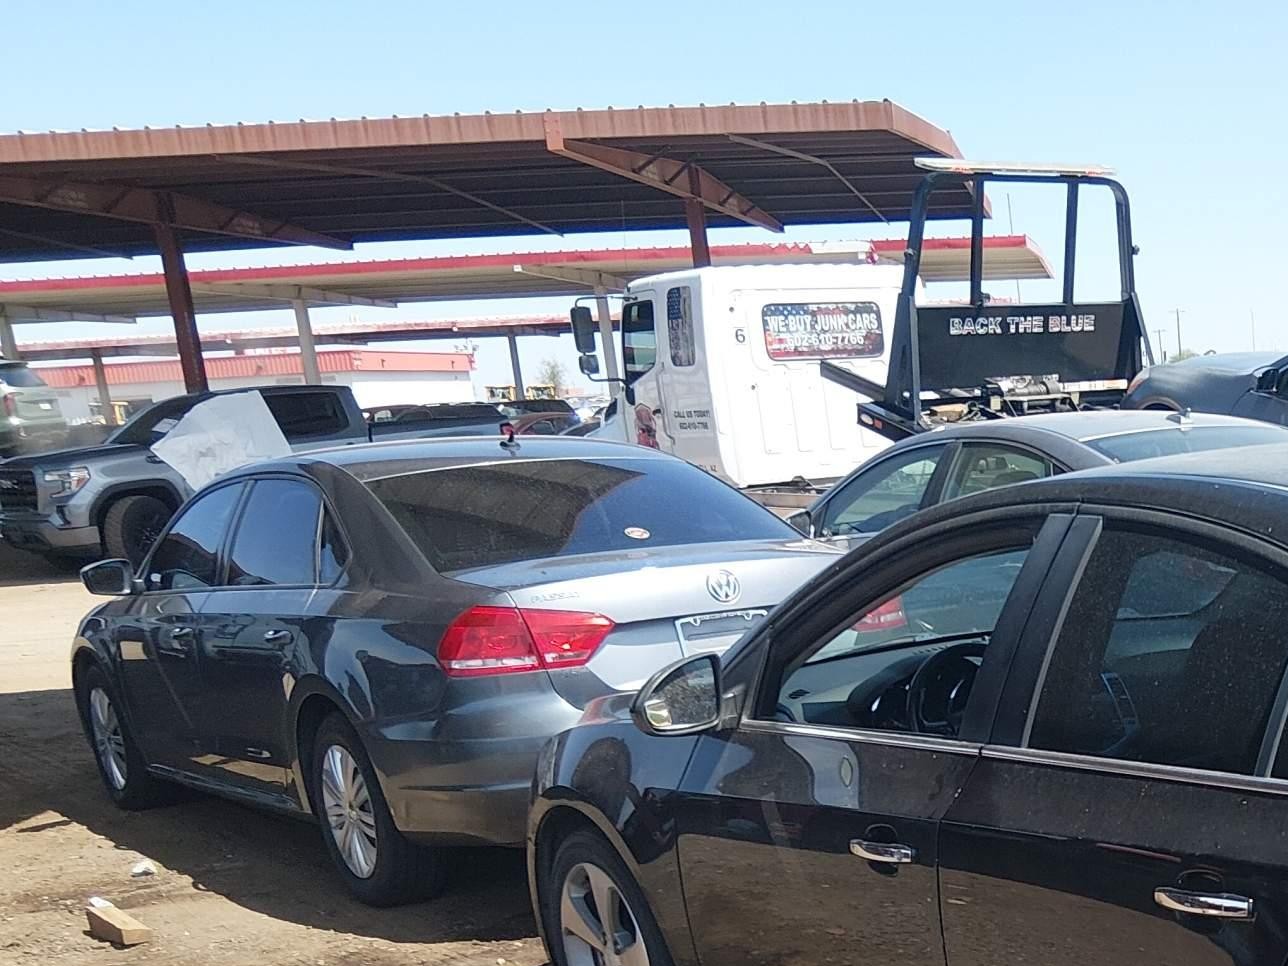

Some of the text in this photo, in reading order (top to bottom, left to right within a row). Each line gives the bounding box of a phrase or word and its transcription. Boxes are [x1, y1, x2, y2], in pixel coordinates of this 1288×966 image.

[766, 313, 878, 332] WE BUY JUNK CARS
[950, 315, 1095, 335] BACK THE BLUE
[735, 329, 746, 343] 6
